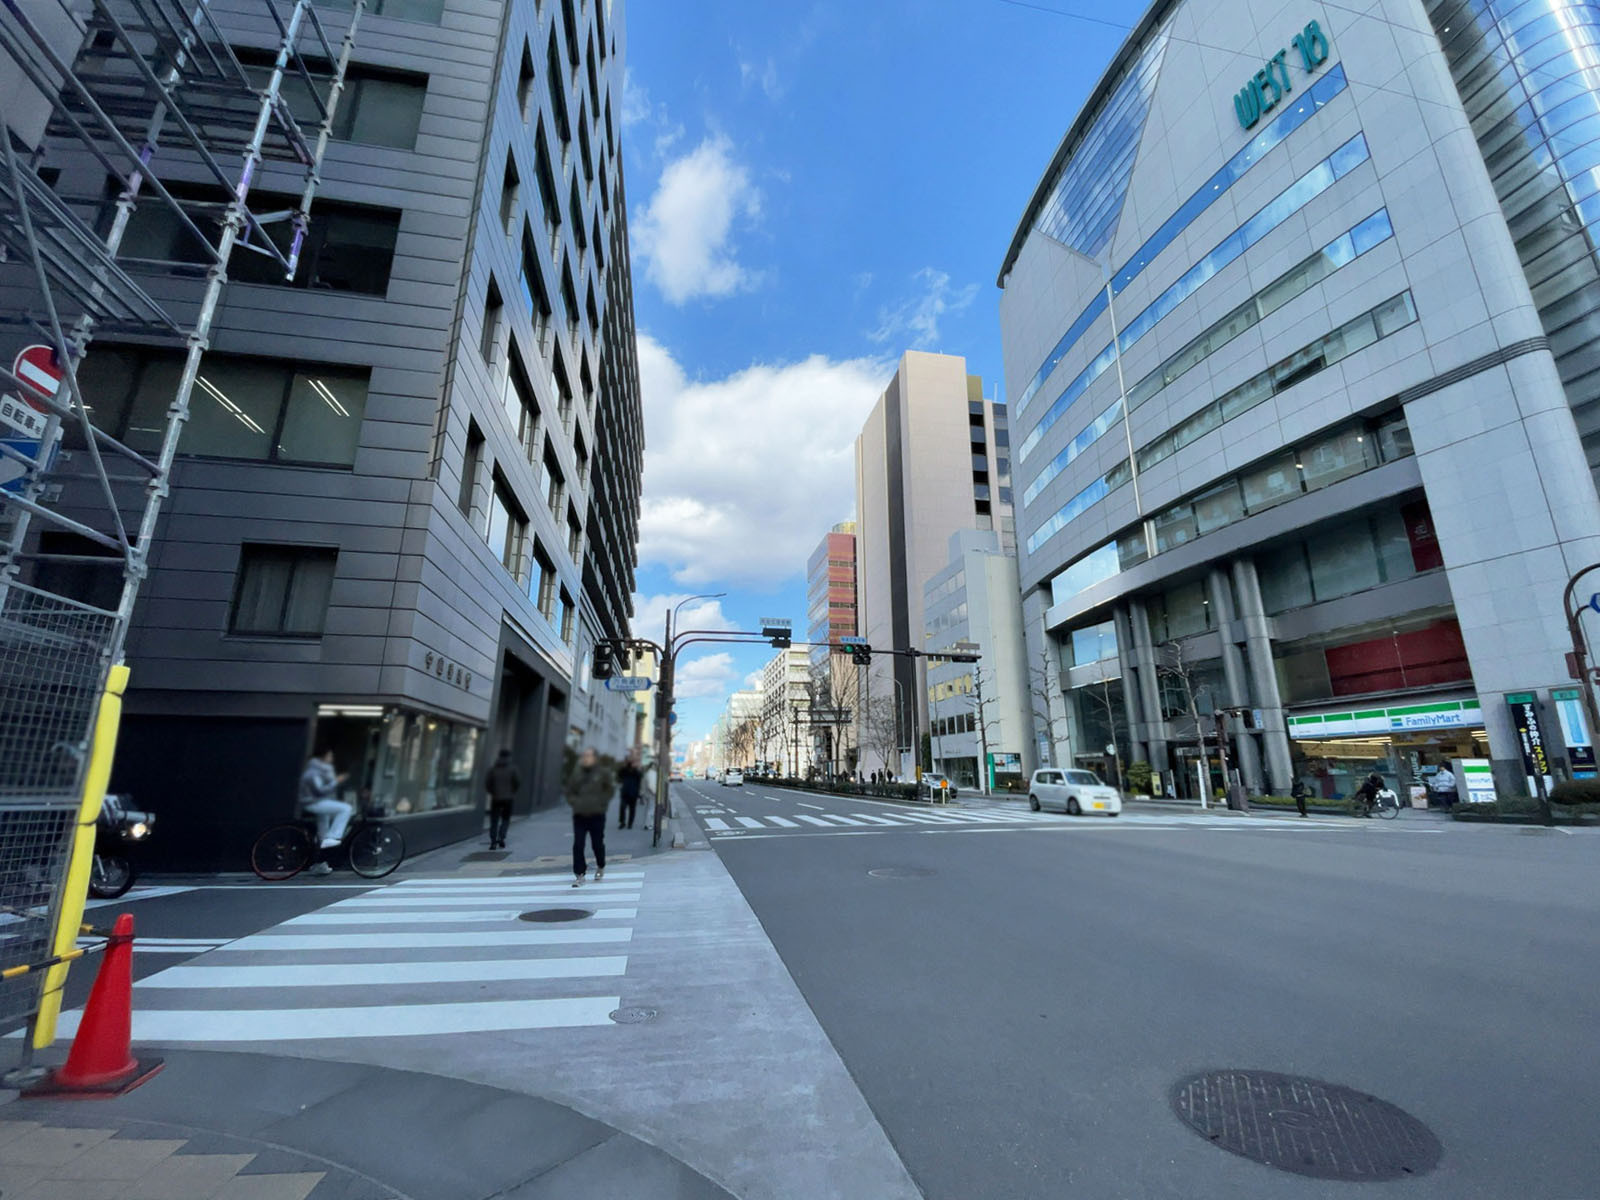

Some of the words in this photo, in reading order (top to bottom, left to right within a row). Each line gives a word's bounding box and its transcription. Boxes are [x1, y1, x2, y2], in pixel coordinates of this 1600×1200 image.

[1233, 48, 1292, 130] WEST
[1291, 19, 1329, 74] 18
[1405, 713, 1461, 727] FamilyMart
